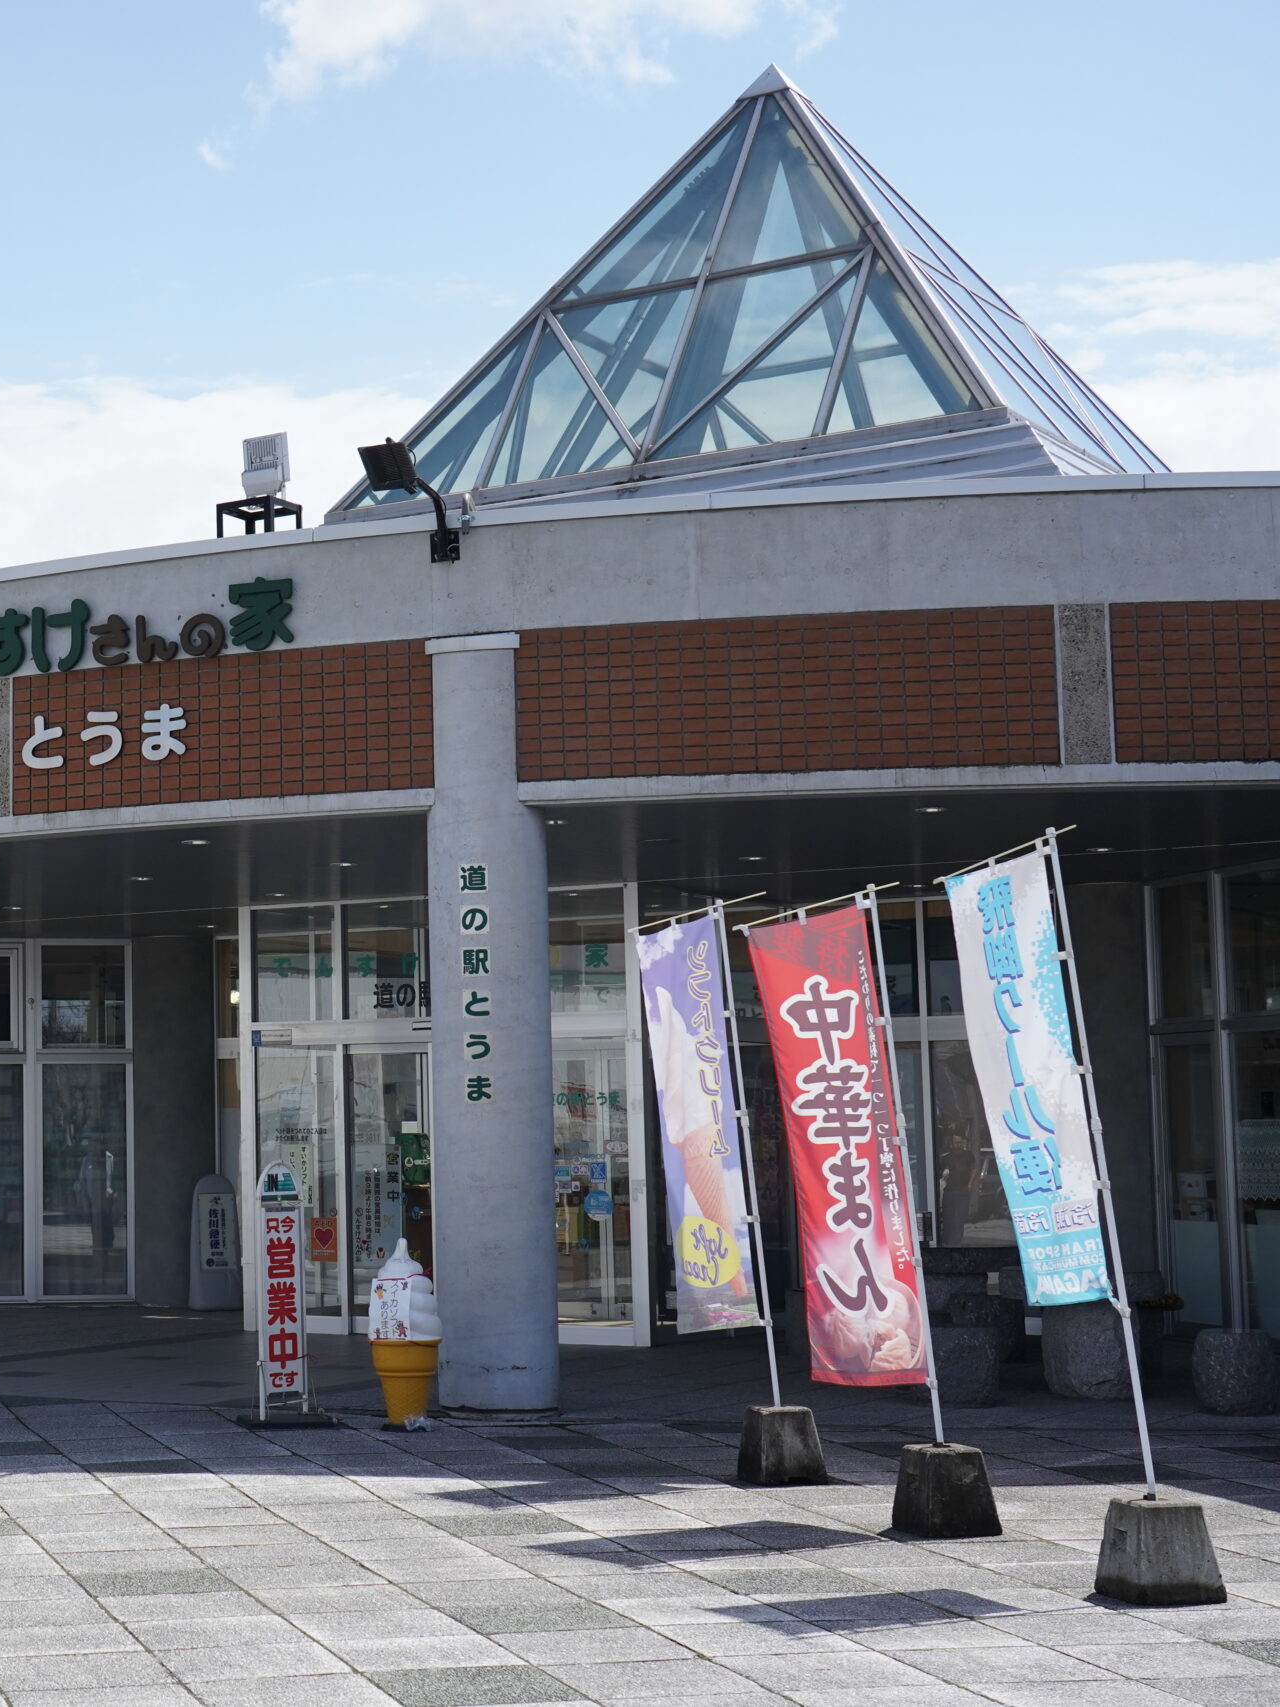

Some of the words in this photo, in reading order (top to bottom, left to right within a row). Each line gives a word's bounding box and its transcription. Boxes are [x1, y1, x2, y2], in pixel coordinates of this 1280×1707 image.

[21, 703, 187, 770] とうま
[460, 865, 493, 1102] 道の駅とうま
[266, 1215, 296, 1234] 只今
[266, 1236, 298, 1369] 営業中
[269, 1371, 299, 1388] です
